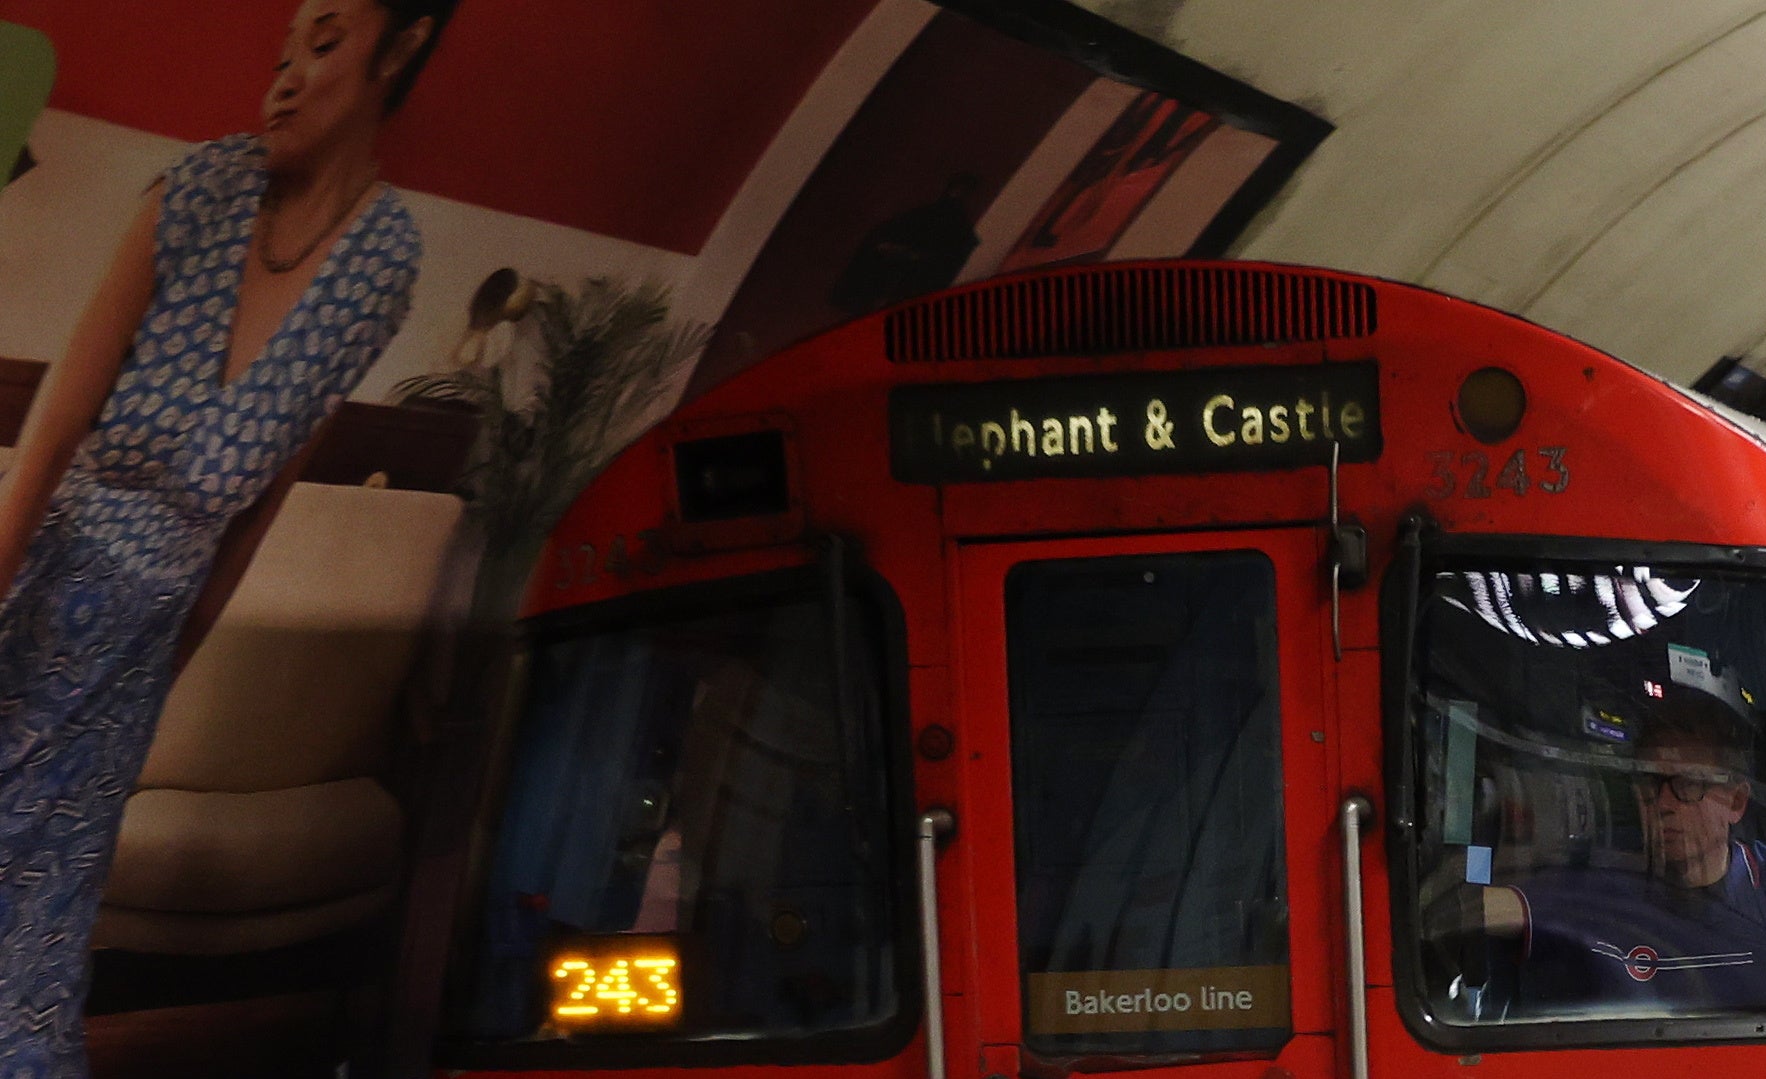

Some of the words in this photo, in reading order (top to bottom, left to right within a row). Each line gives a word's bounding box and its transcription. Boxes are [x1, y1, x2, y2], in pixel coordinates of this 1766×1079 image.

[906, 405, 1118, 470] lephant
[1145, 399, 1175, 451] &
[1202, 391, 1367, 447] Castle
[1425, 447, 1572, 500] 3243
[552, 957, 680, 1019] 243
[1064, 986, 1192, 1017] Bakerloo
[1200, 983, 1254, 1013] line
